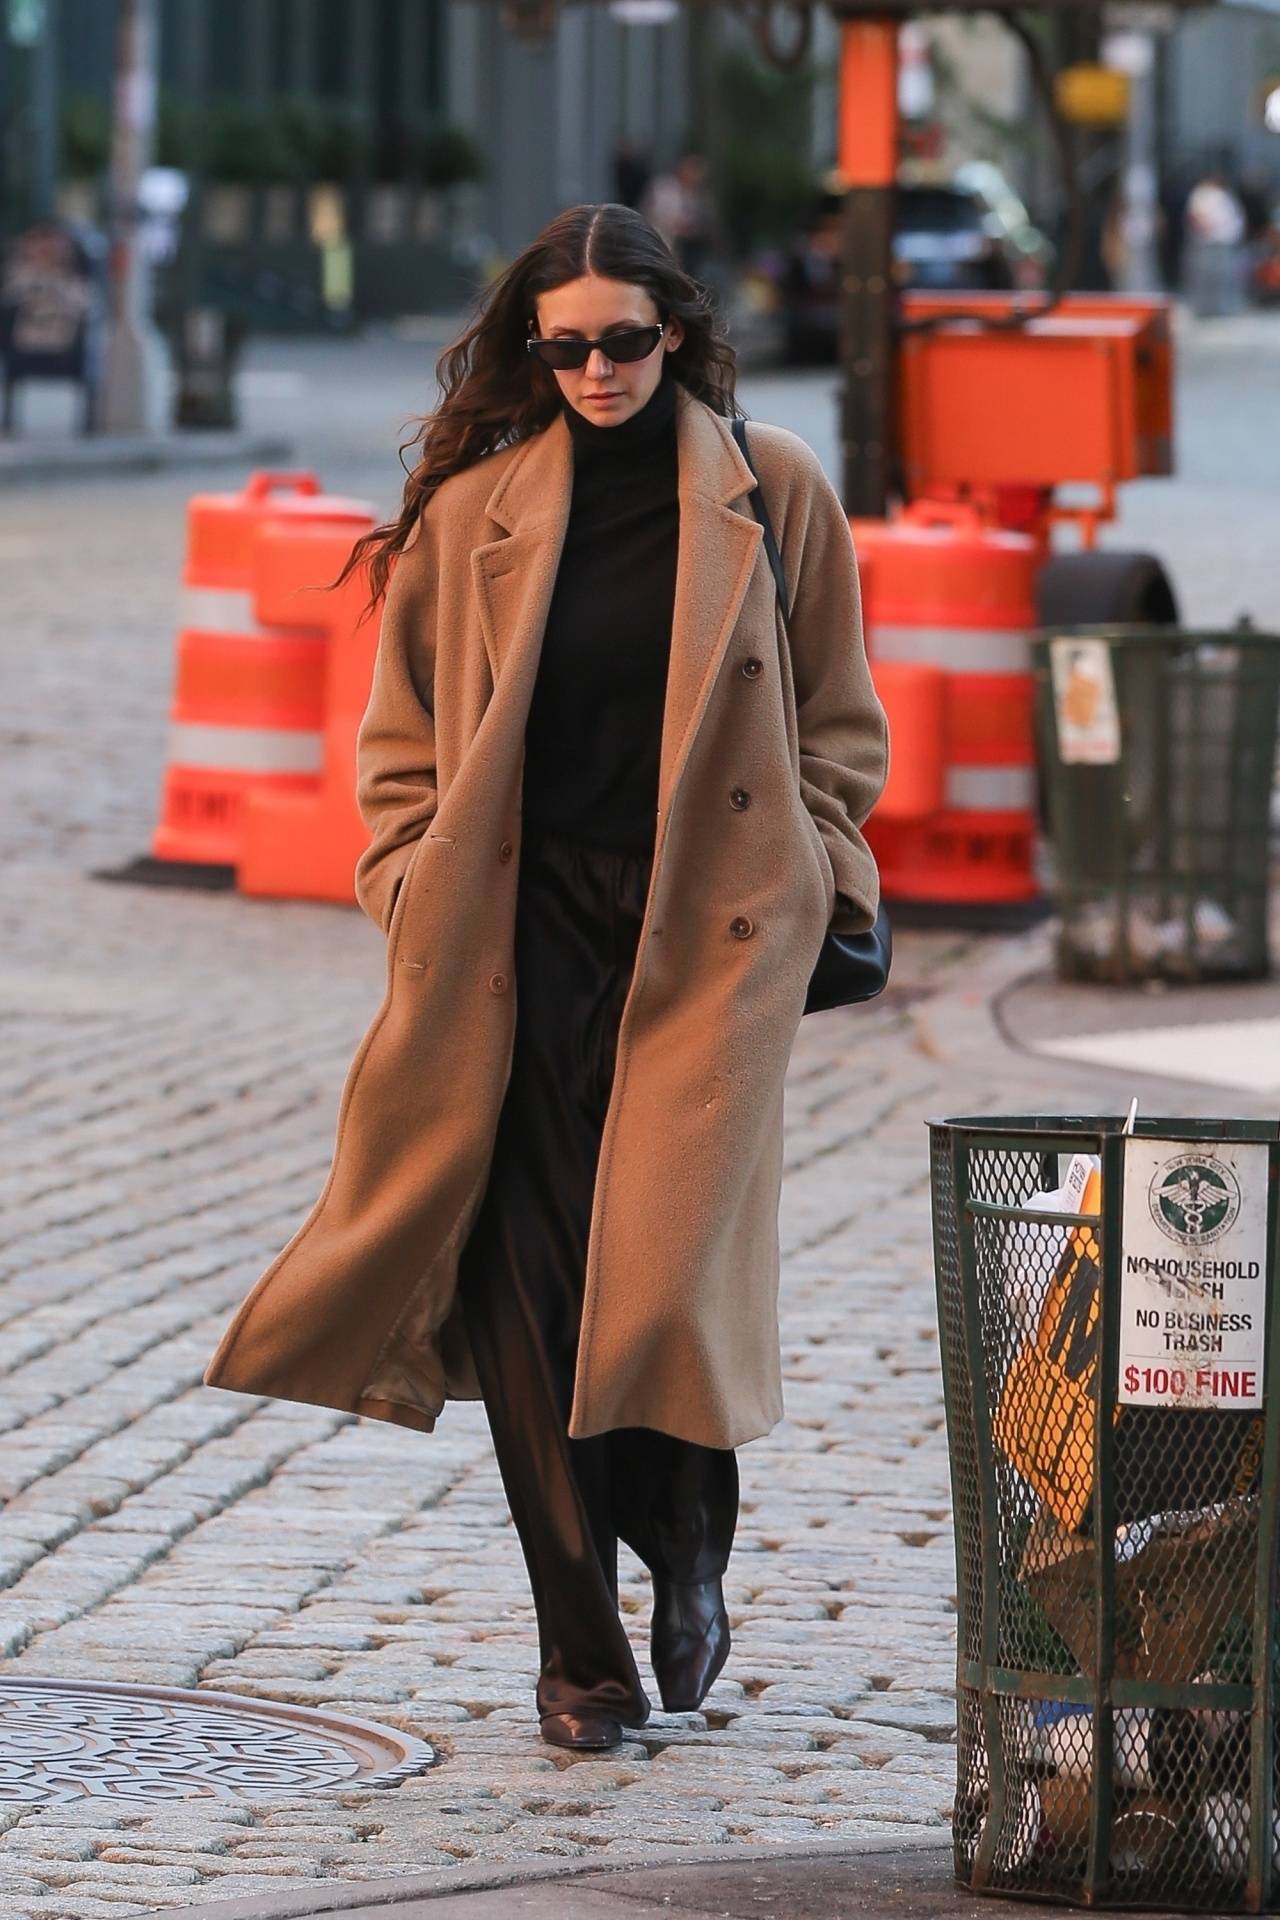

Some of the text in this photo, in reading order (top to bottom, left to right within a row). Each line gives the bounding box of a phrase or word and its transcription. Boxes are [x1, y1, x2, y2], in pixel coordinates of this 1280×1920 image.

[1126, 1256, 1260, 1279] NO HOUSEHOLD
[1136, 1309, 1253, 1332] NO BUSINESS
[1163, 1332, 1223, 1353] TRASH
[1124, 1364, 1257, 1398] $100 FINE
